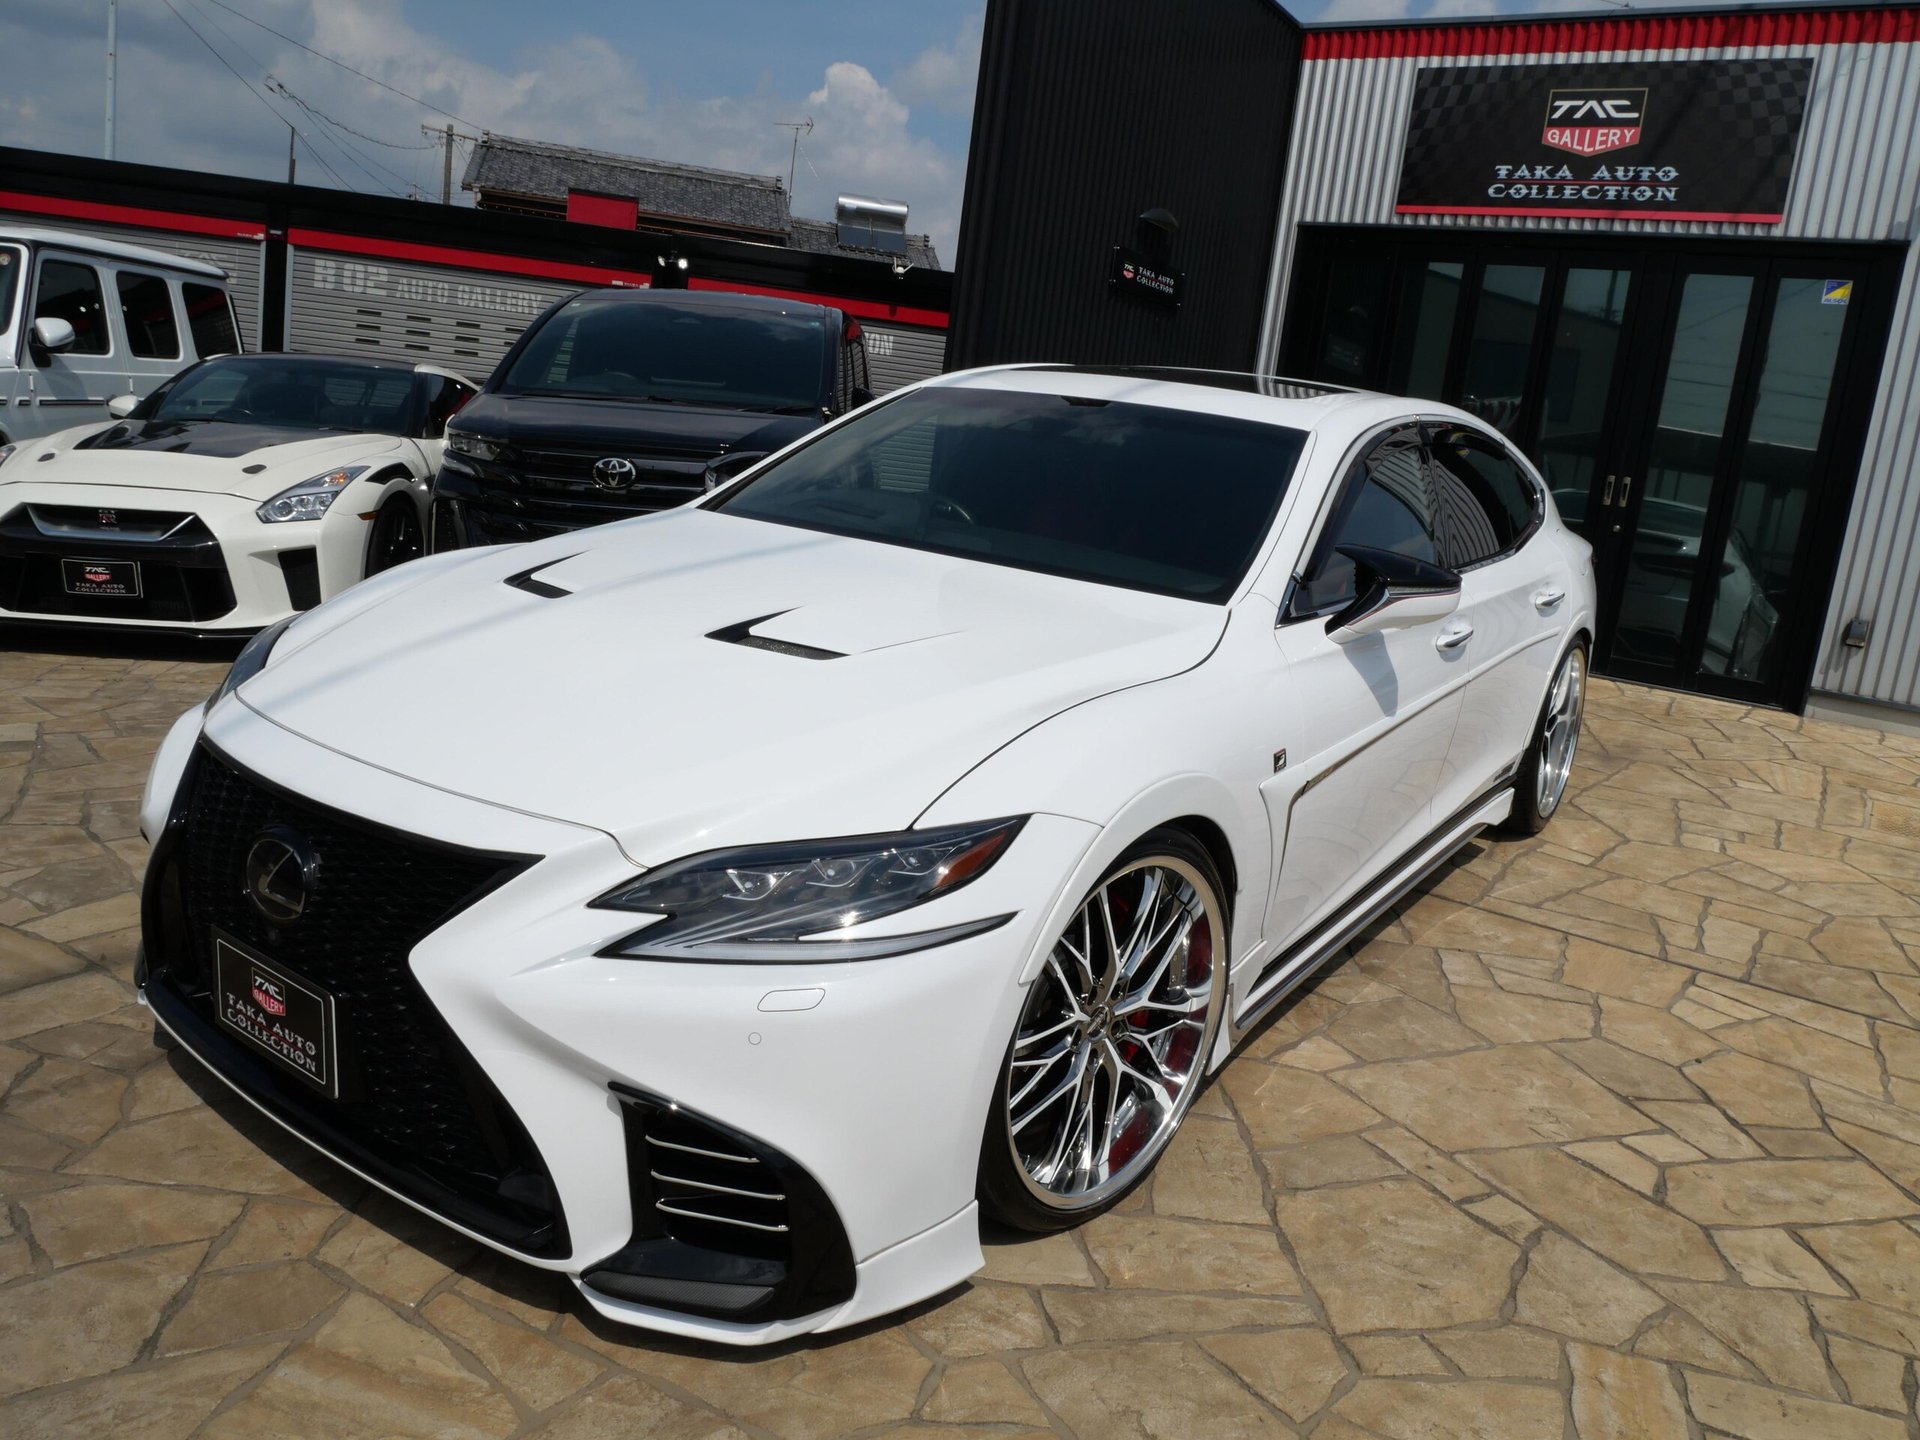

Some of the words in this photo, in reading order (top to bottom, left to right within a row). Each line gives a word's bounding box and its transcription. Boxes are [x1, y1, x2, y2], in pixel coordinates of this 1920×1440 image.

[1551, 99, 1640, 119] TAC
[1547, 128, 1635, 152] GALLERY
[1494, 164, 1574, 180] TAKA
[1590, 164, 1680, 182] AUTO
[1487, 183, 1680, 201] COLLECTION
[1136, 274, 1174, 295] COLLECTION
[1138, 266, 1156, 279] TAKA
[1157, 274, 1175, 287] AUTO
[396, 277, 449, 304] AUTO
[458, 284, 542, 315] GALLERY
[254, 975, 283, 1001] TAC
[253, 989, 285, 1014] GALLERY
[226, 992, 267, 1026] TAKA
[273, 1022, 316, 1056] AUTO
[227, 1008, 316, 1073] COLLECTION
